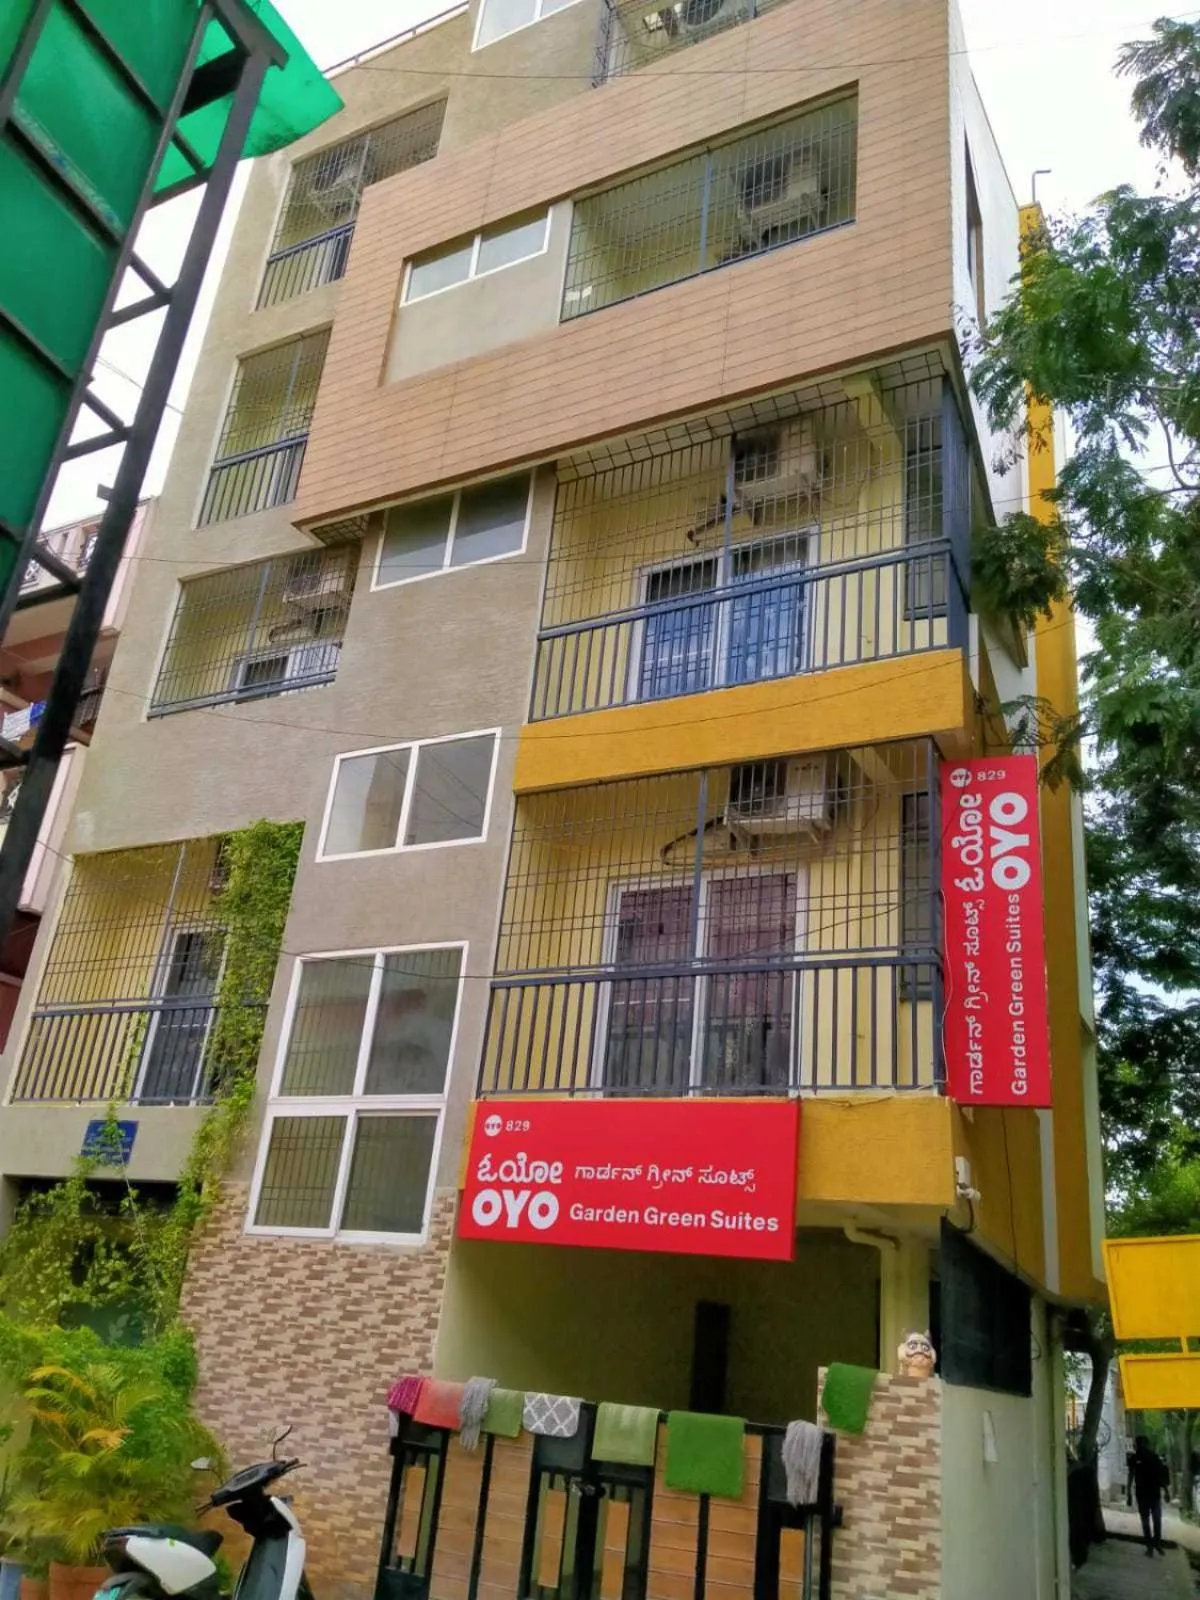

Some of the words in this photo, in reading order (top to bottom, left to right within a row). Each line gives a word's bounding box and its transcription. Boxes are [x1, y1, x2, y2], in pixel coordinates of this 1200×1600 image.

[976, 769, 1006, 782] 829
[951, 793, 984, 892] ಓಯೋ
[988, 791, 1031, 891] OYO
[1005, 893, 1022, 953] Suites
[1007, 957, 1024, 1016] Green
[964, 1014, 984, 1095] ಗಾರ್ಡನ್
[1010, 1020, 1027, 1096] Garden
[505, 1120, 531, 1132] 829
[476, 1152, 564, 1185] ಓಯೋ
[574, 1162, 643, 1181] ಗಾರ್ಡನ್
[646, 1164, 694, 1189] ಗ್ರೀನ್
[471, 1187, 561, 1231] OYO
[569, 1203, 640, 1225] Garden
[643, 1206, 706, 1228] Green
[710, 1209, 779, 1232] Suites
